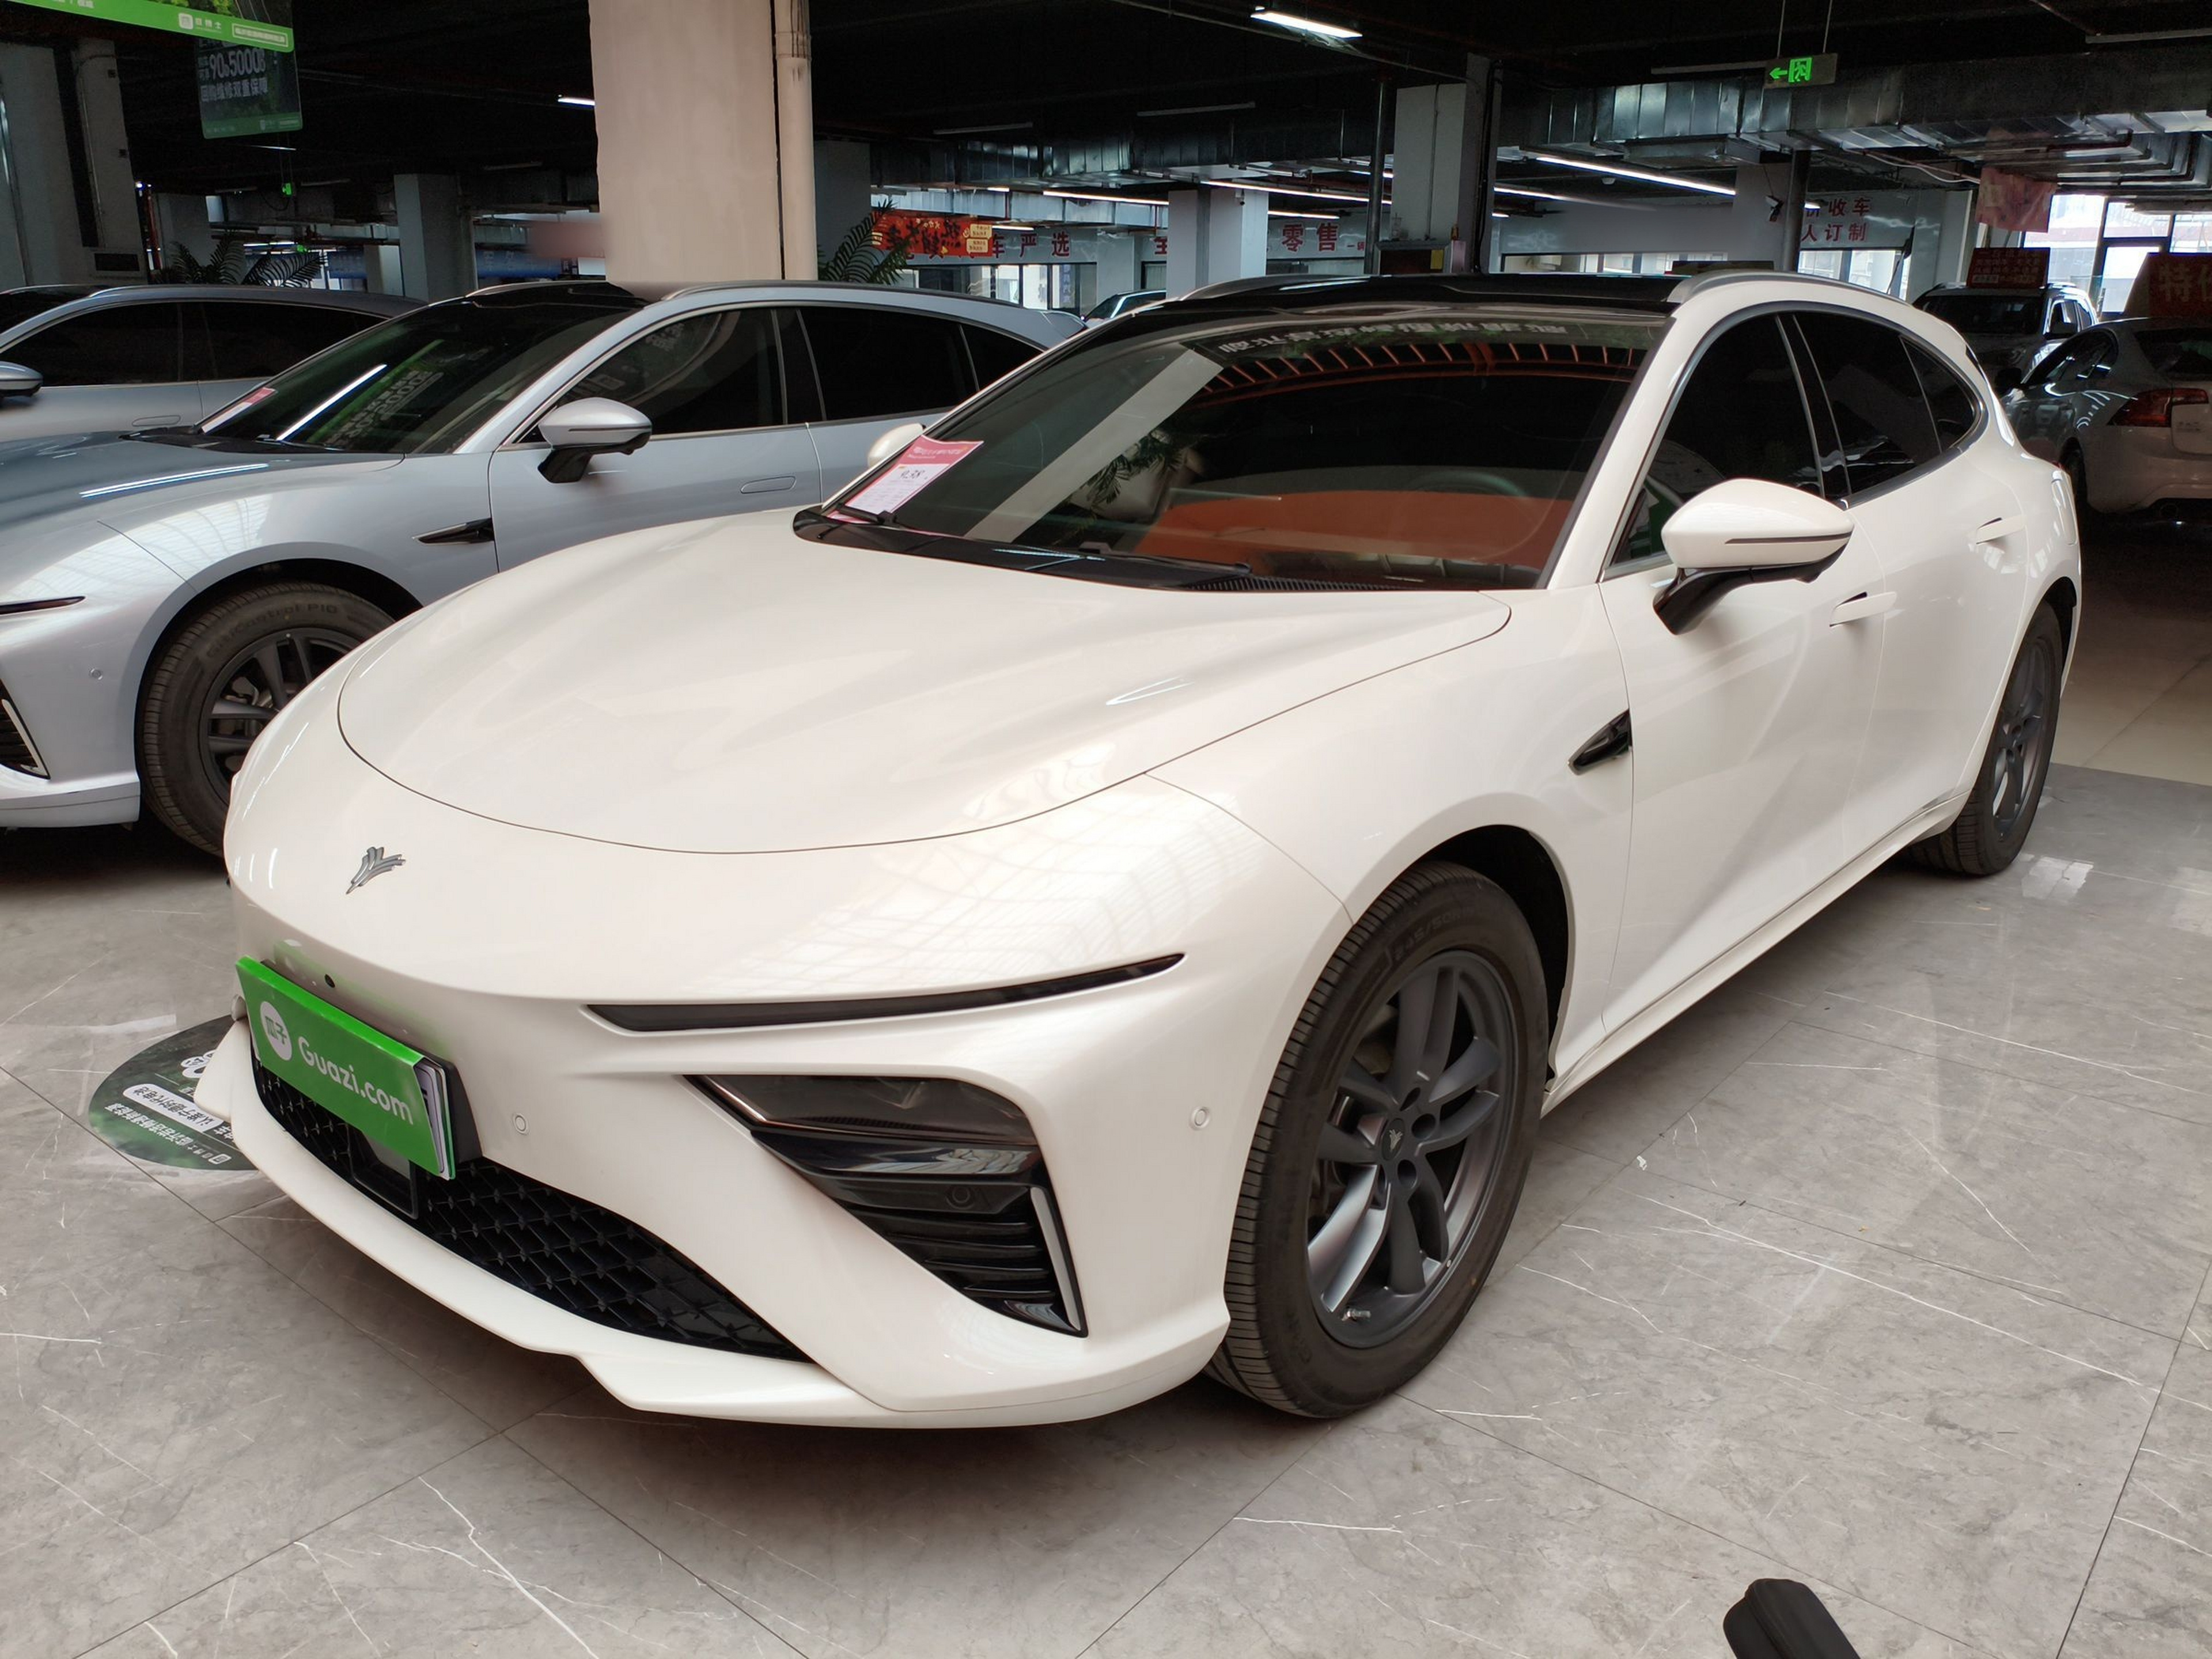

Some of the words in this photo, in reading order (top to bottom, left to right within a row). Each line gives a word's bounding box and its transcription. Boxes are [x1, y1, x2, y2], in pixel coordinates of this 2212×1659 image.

[1281, 222, 1339, 252] 零售
[307, 603, 338, 614] P10
[264, 1015, 288, 1046] 瓜子
[298, 1036, 414, 1125] Guazi.com
